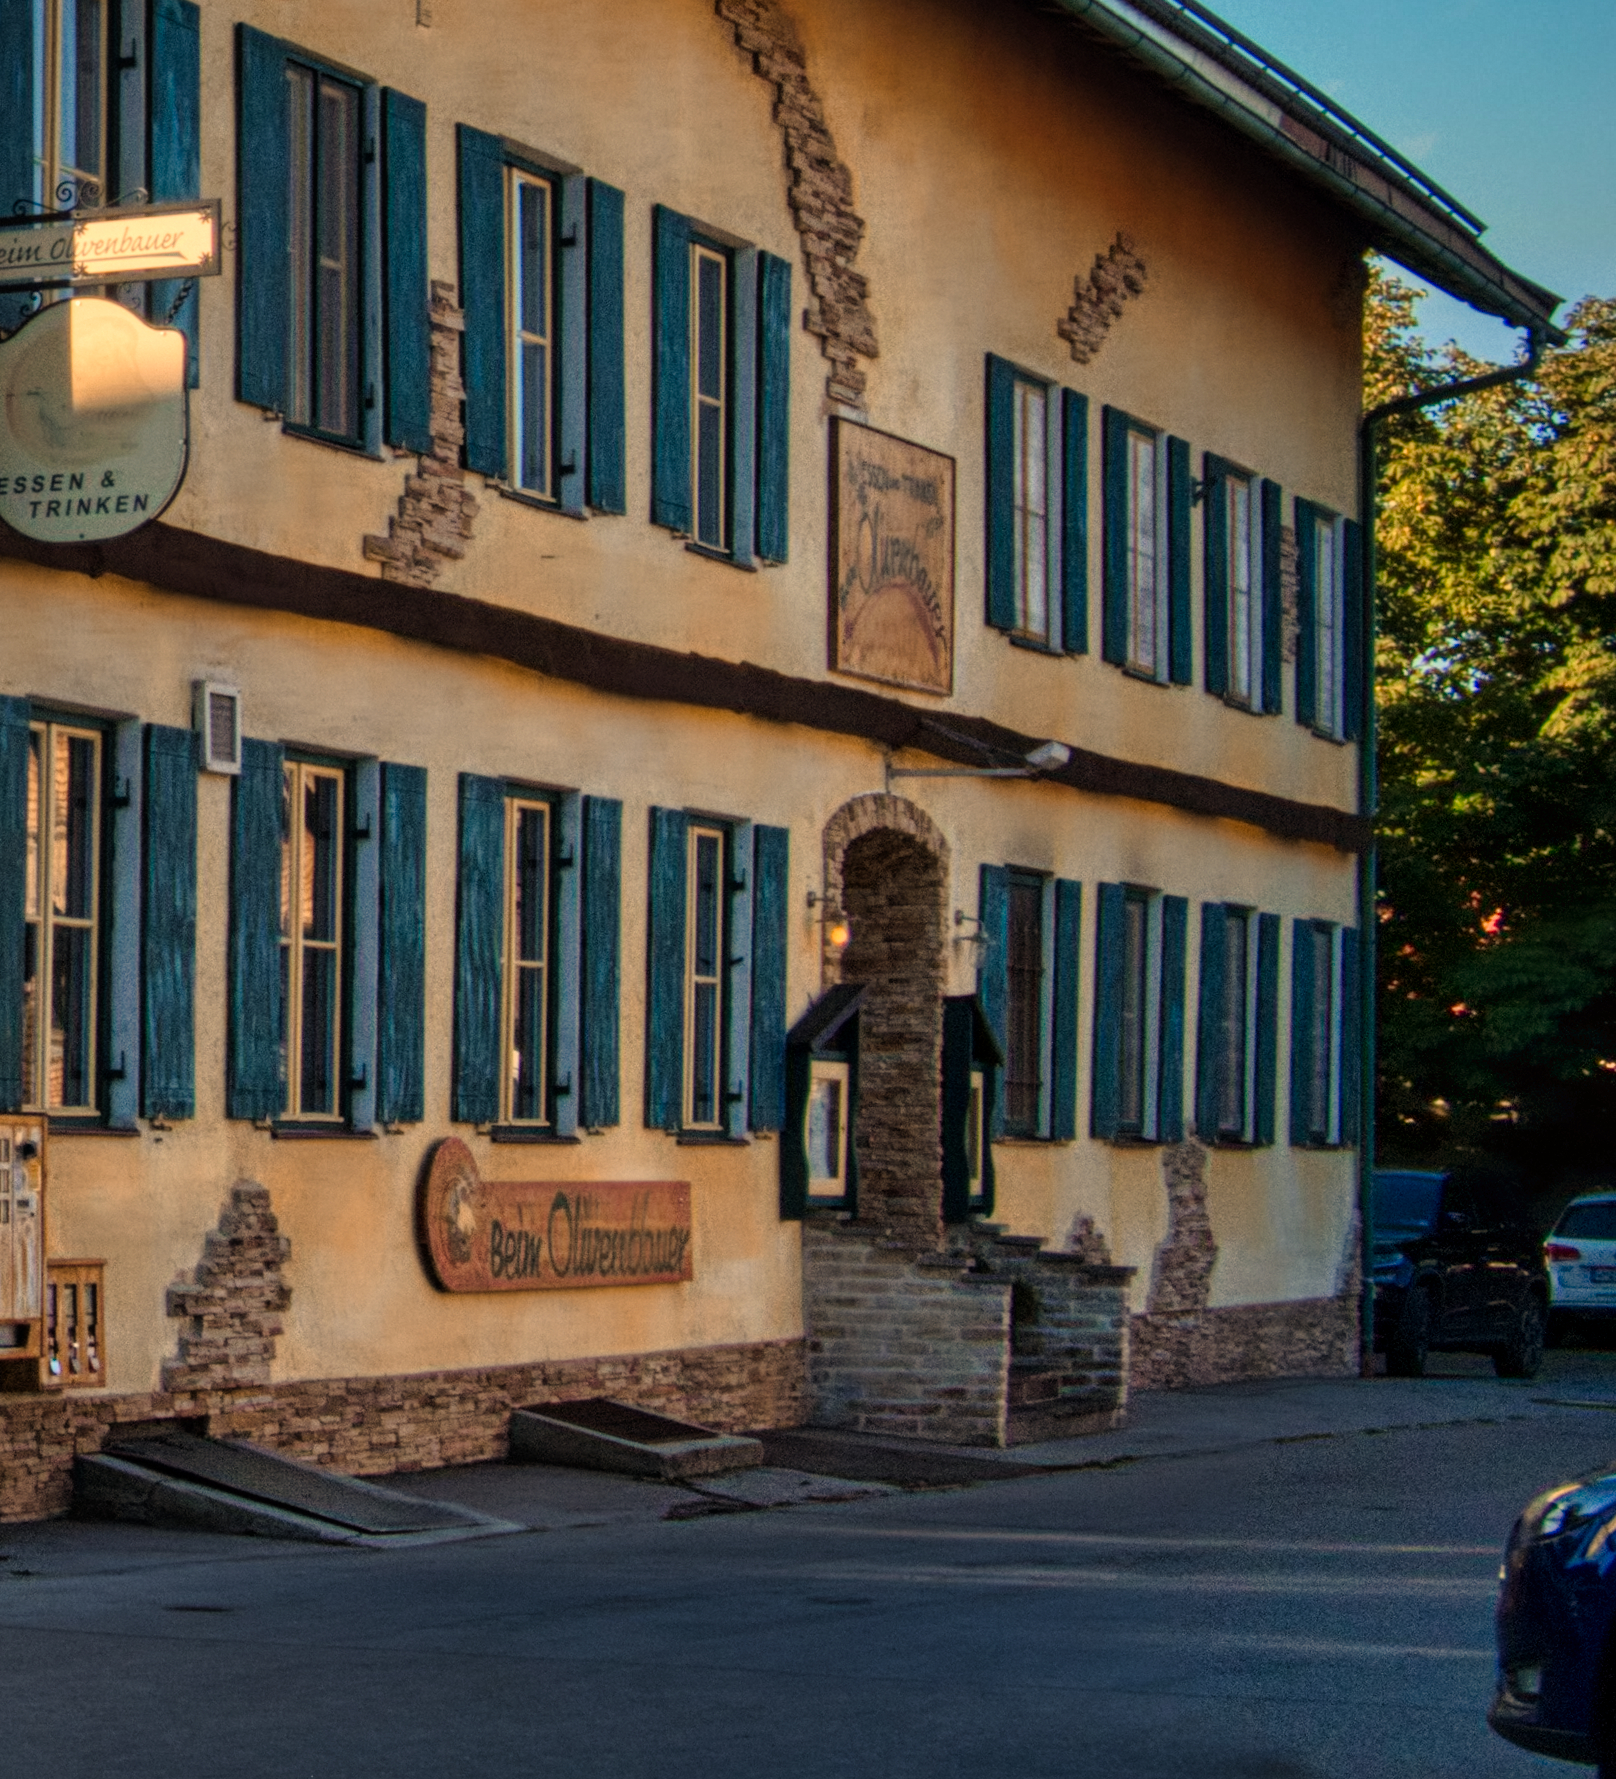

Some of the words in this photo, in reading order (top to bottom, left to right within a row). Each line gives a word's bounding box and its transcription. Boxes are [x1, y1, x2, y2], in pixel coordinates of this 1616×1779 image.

[49, 225, 185, 261] Olivenbauer
[100, 470, 116, 488] &
[29, 493, 150, 520] TRINKEN
[489, 1202, 543, 1280] Beim
